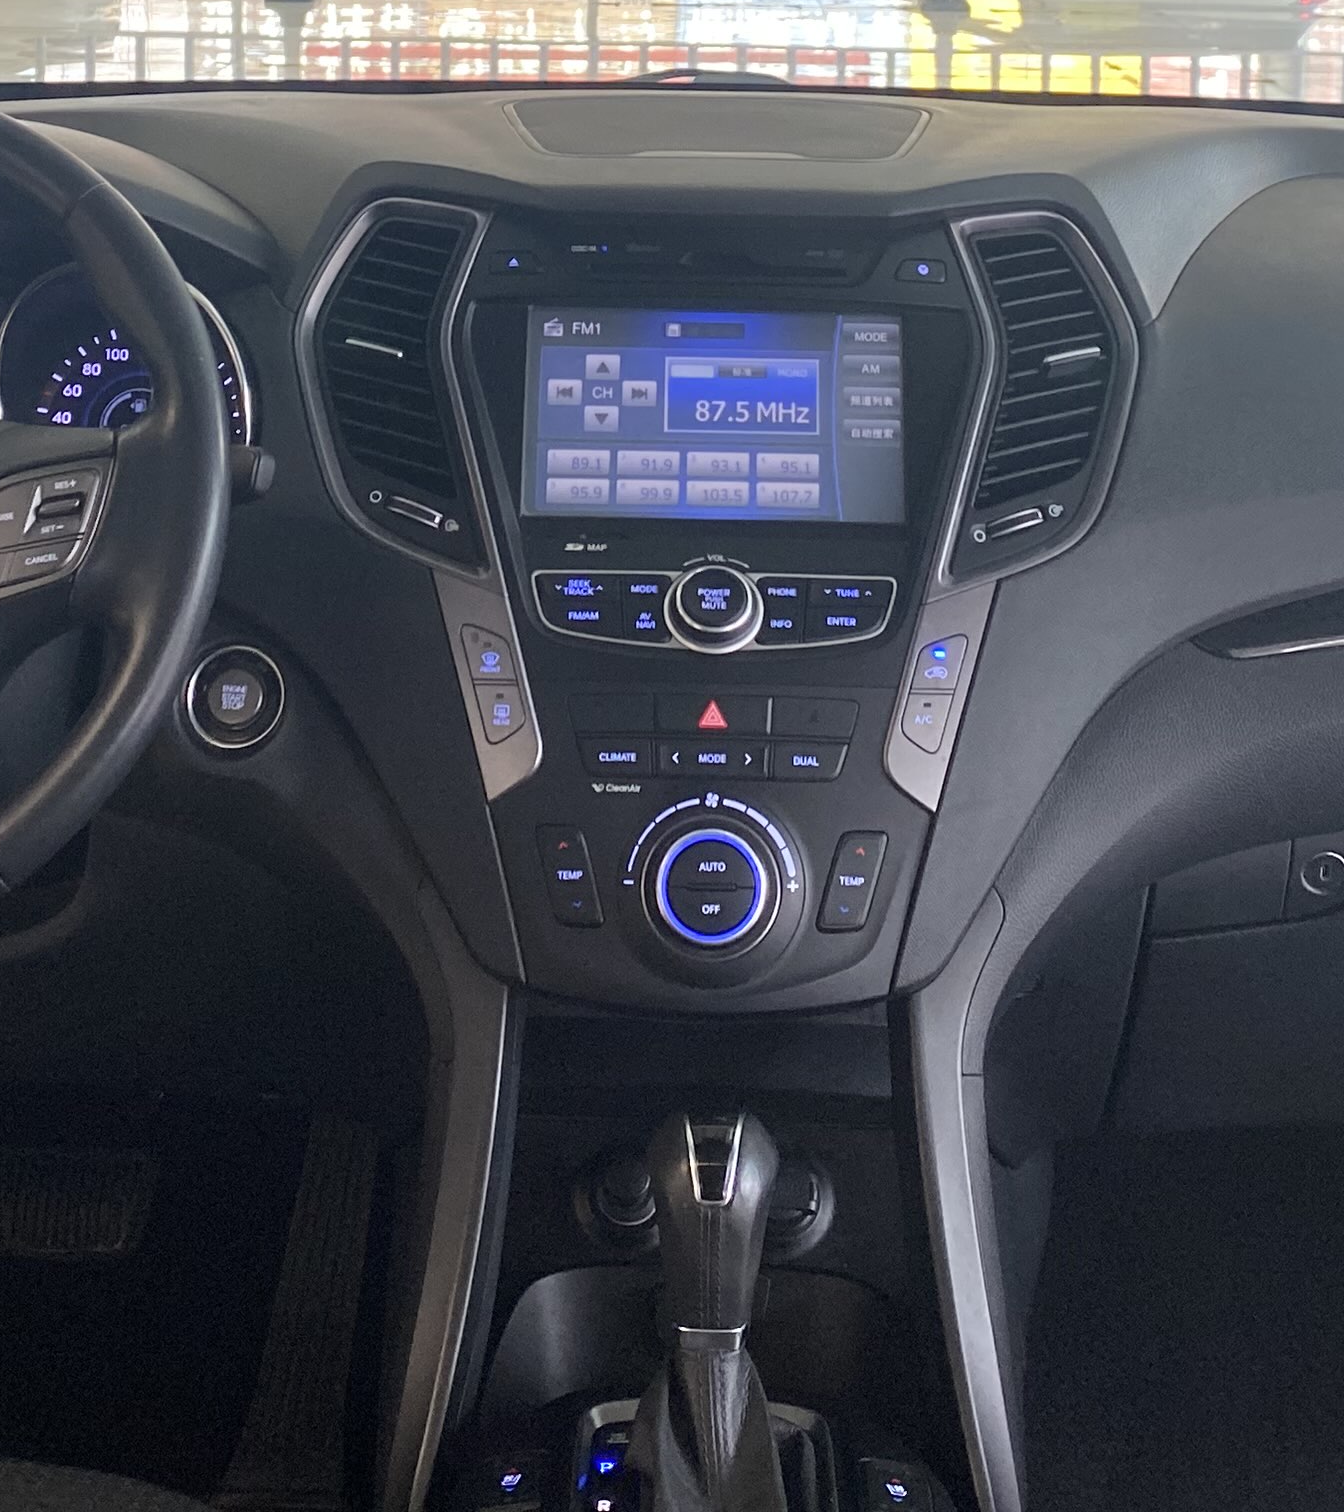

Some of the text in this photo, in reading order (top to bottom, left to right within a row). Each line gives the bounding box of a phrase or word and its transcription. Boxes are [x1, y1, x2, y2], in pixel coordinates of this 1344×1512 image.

[572, 322, 601, 335] FM1
[854, 332, 888, 342] MODE
[105, 348, 129, 361] 100
[82, 363, 101, 376] 80
[861, 364, 881, 374] AM
[62, 384, 82, 397] 60
[592, 386, 613, 399] CH
[52, 411, 72, 424] 40
[695, 400, 810, 424] 87.5 MHz
[571, 456, 601, 470] 89.1
[640, 458, 673, 472] 91.9
[711, 459, 741, 473] 93.1
[780, 461, 811, 474] 95.1
[570, 486, 602, 499] 95.9
[703, 488, 743, 502] 103.5
[772, 490, 813, 504] 107.7
[587, 543, 608, 551] MAP
[25, 553, 58, 565] CANCEL
[707, 554, 726, 562] VOL
[568, 579, 591, 587] SEEK
[563, 587, 594, 596] TRACK
[630, 585, 658, 594] MODE
[697, 588, 730, 597] POWER
[767, 588, 796, 597] PHONE
[835, 589, 859, 598] TUNE
[701, 601, 726, 610] MUTE
[568, 612, 599, 620] FM/AM
[826, 617, 856, 626] ENTER
[770, 619, 792, 629] INFO
[914, 715, 933, 724] A/C
[599, 752, 637, 763] CLIMATE
[698, 753, 727, 764] MODE
[793, 756, 819, 767] DUAL
[699, 862, 726, 873] AUTO
[557, 870, 583, 881] TEMP
[839, 876, 865, 886] TEMP
[701, 904, 721, 915] OFF
[599, 1462, 615, 1473] P
[597, 1499, 611, 1511] R
